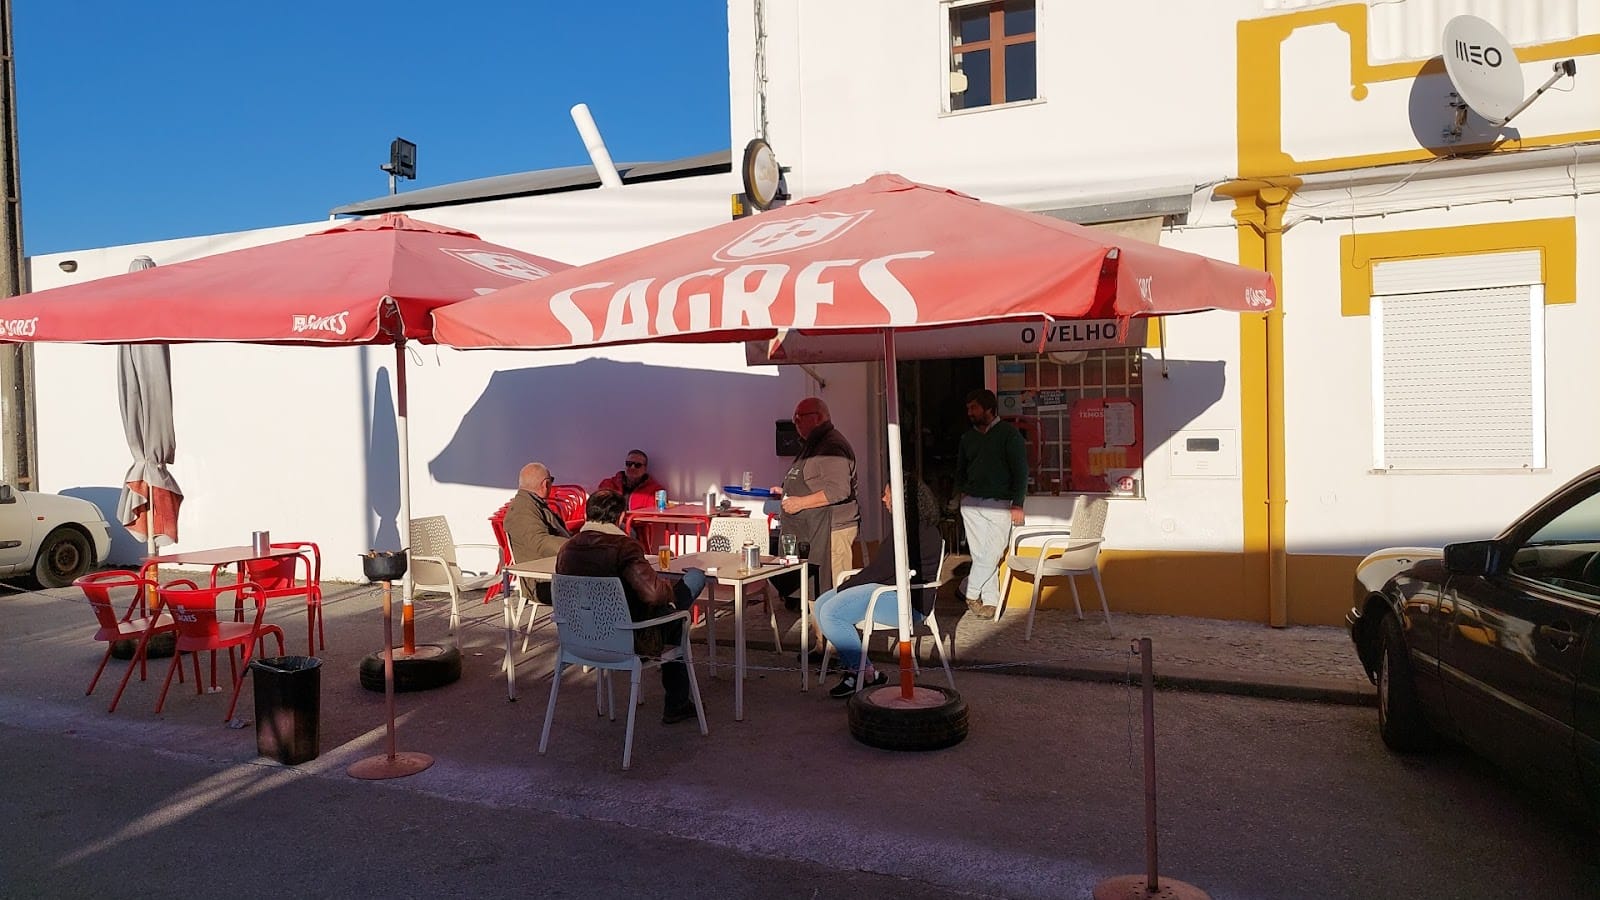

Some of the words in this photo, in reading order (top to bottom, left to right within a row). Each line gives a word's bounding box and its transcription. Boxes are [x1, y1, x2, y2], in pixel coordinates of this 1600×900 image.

[1455, 39, 1502, 68] MEO
[549, 251, 935, 345] SAGRES
[1021, 327, 1036, 344] O
[1042, 322, 1118, 342] VELHO
